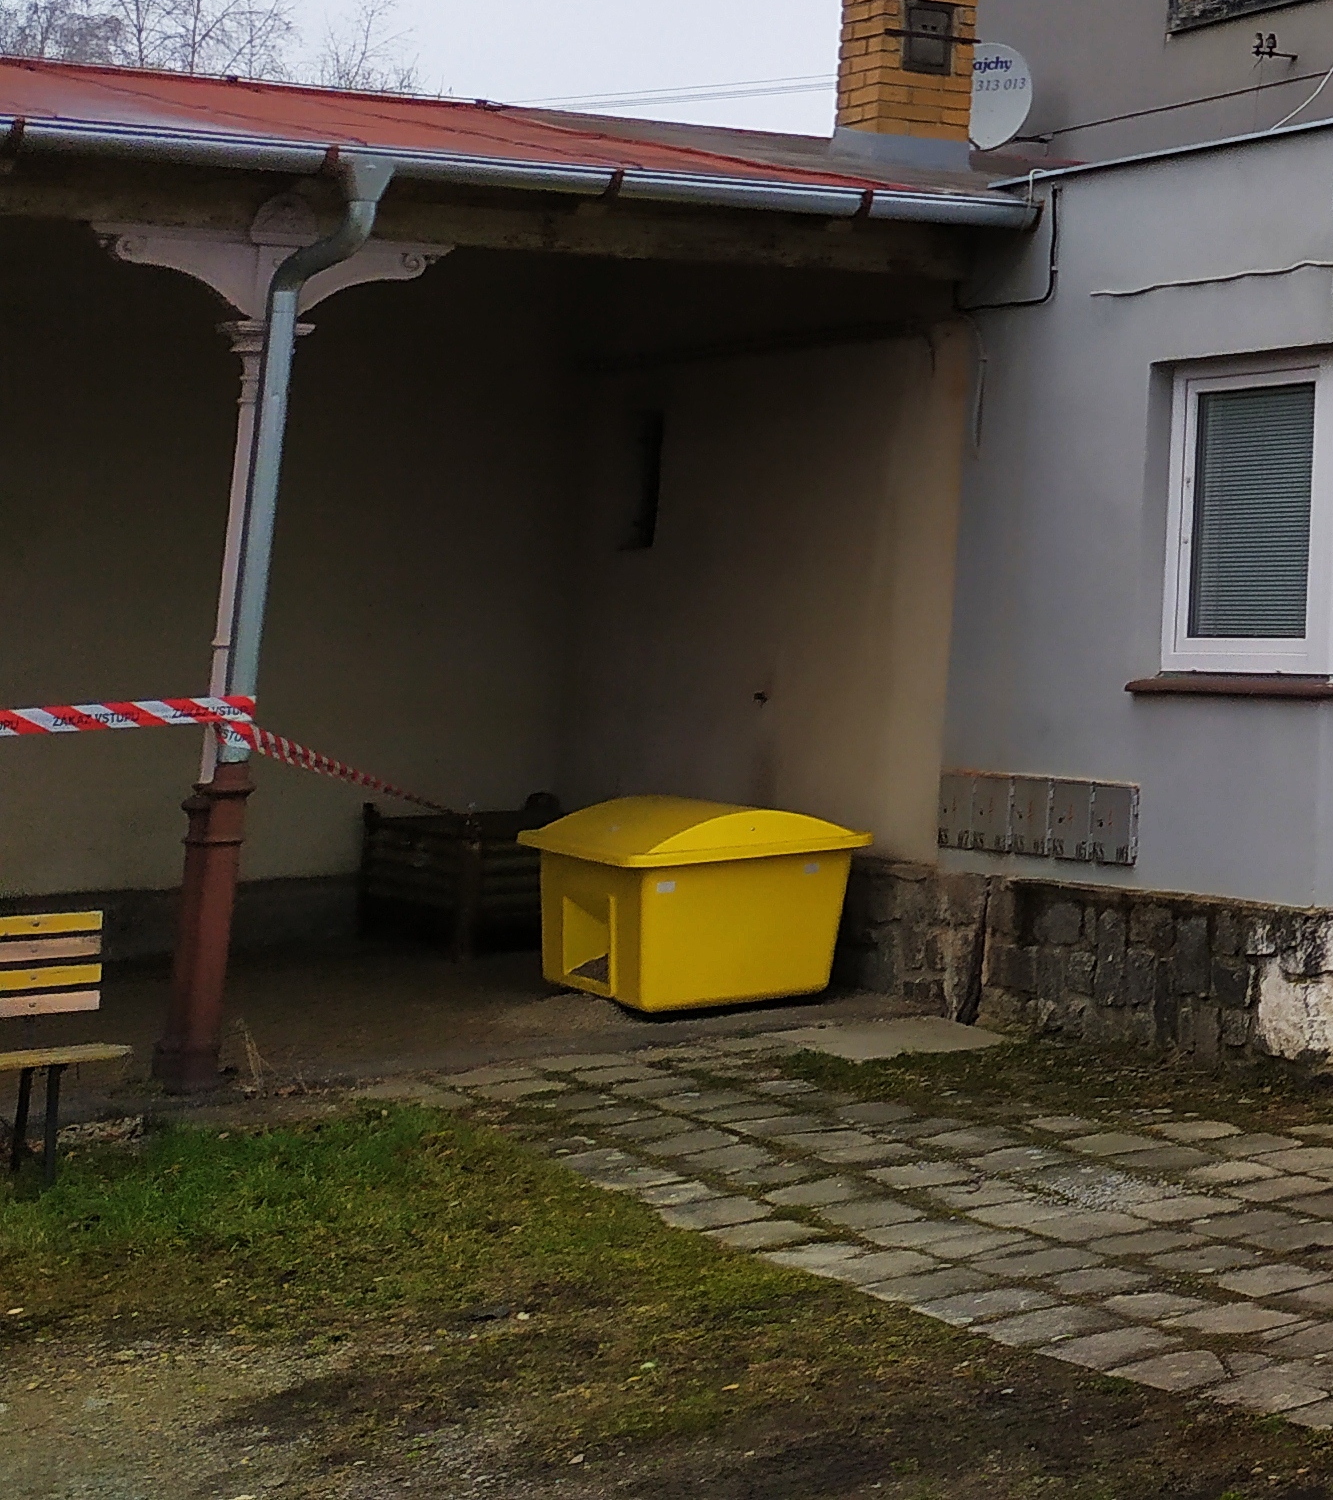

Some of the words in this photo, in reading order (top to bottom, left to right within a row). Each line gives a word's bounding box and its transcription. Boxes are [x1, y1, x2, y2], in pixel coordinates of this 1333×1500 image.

[972, 55, 1013, 74] ajchy
[976, 79, 1000, 92] 313
[1004, 77, 1026, 91] 013
[52, 714, 92, 727] ZÁKAZ
[95, 712, 140, 724] VSTUPU
